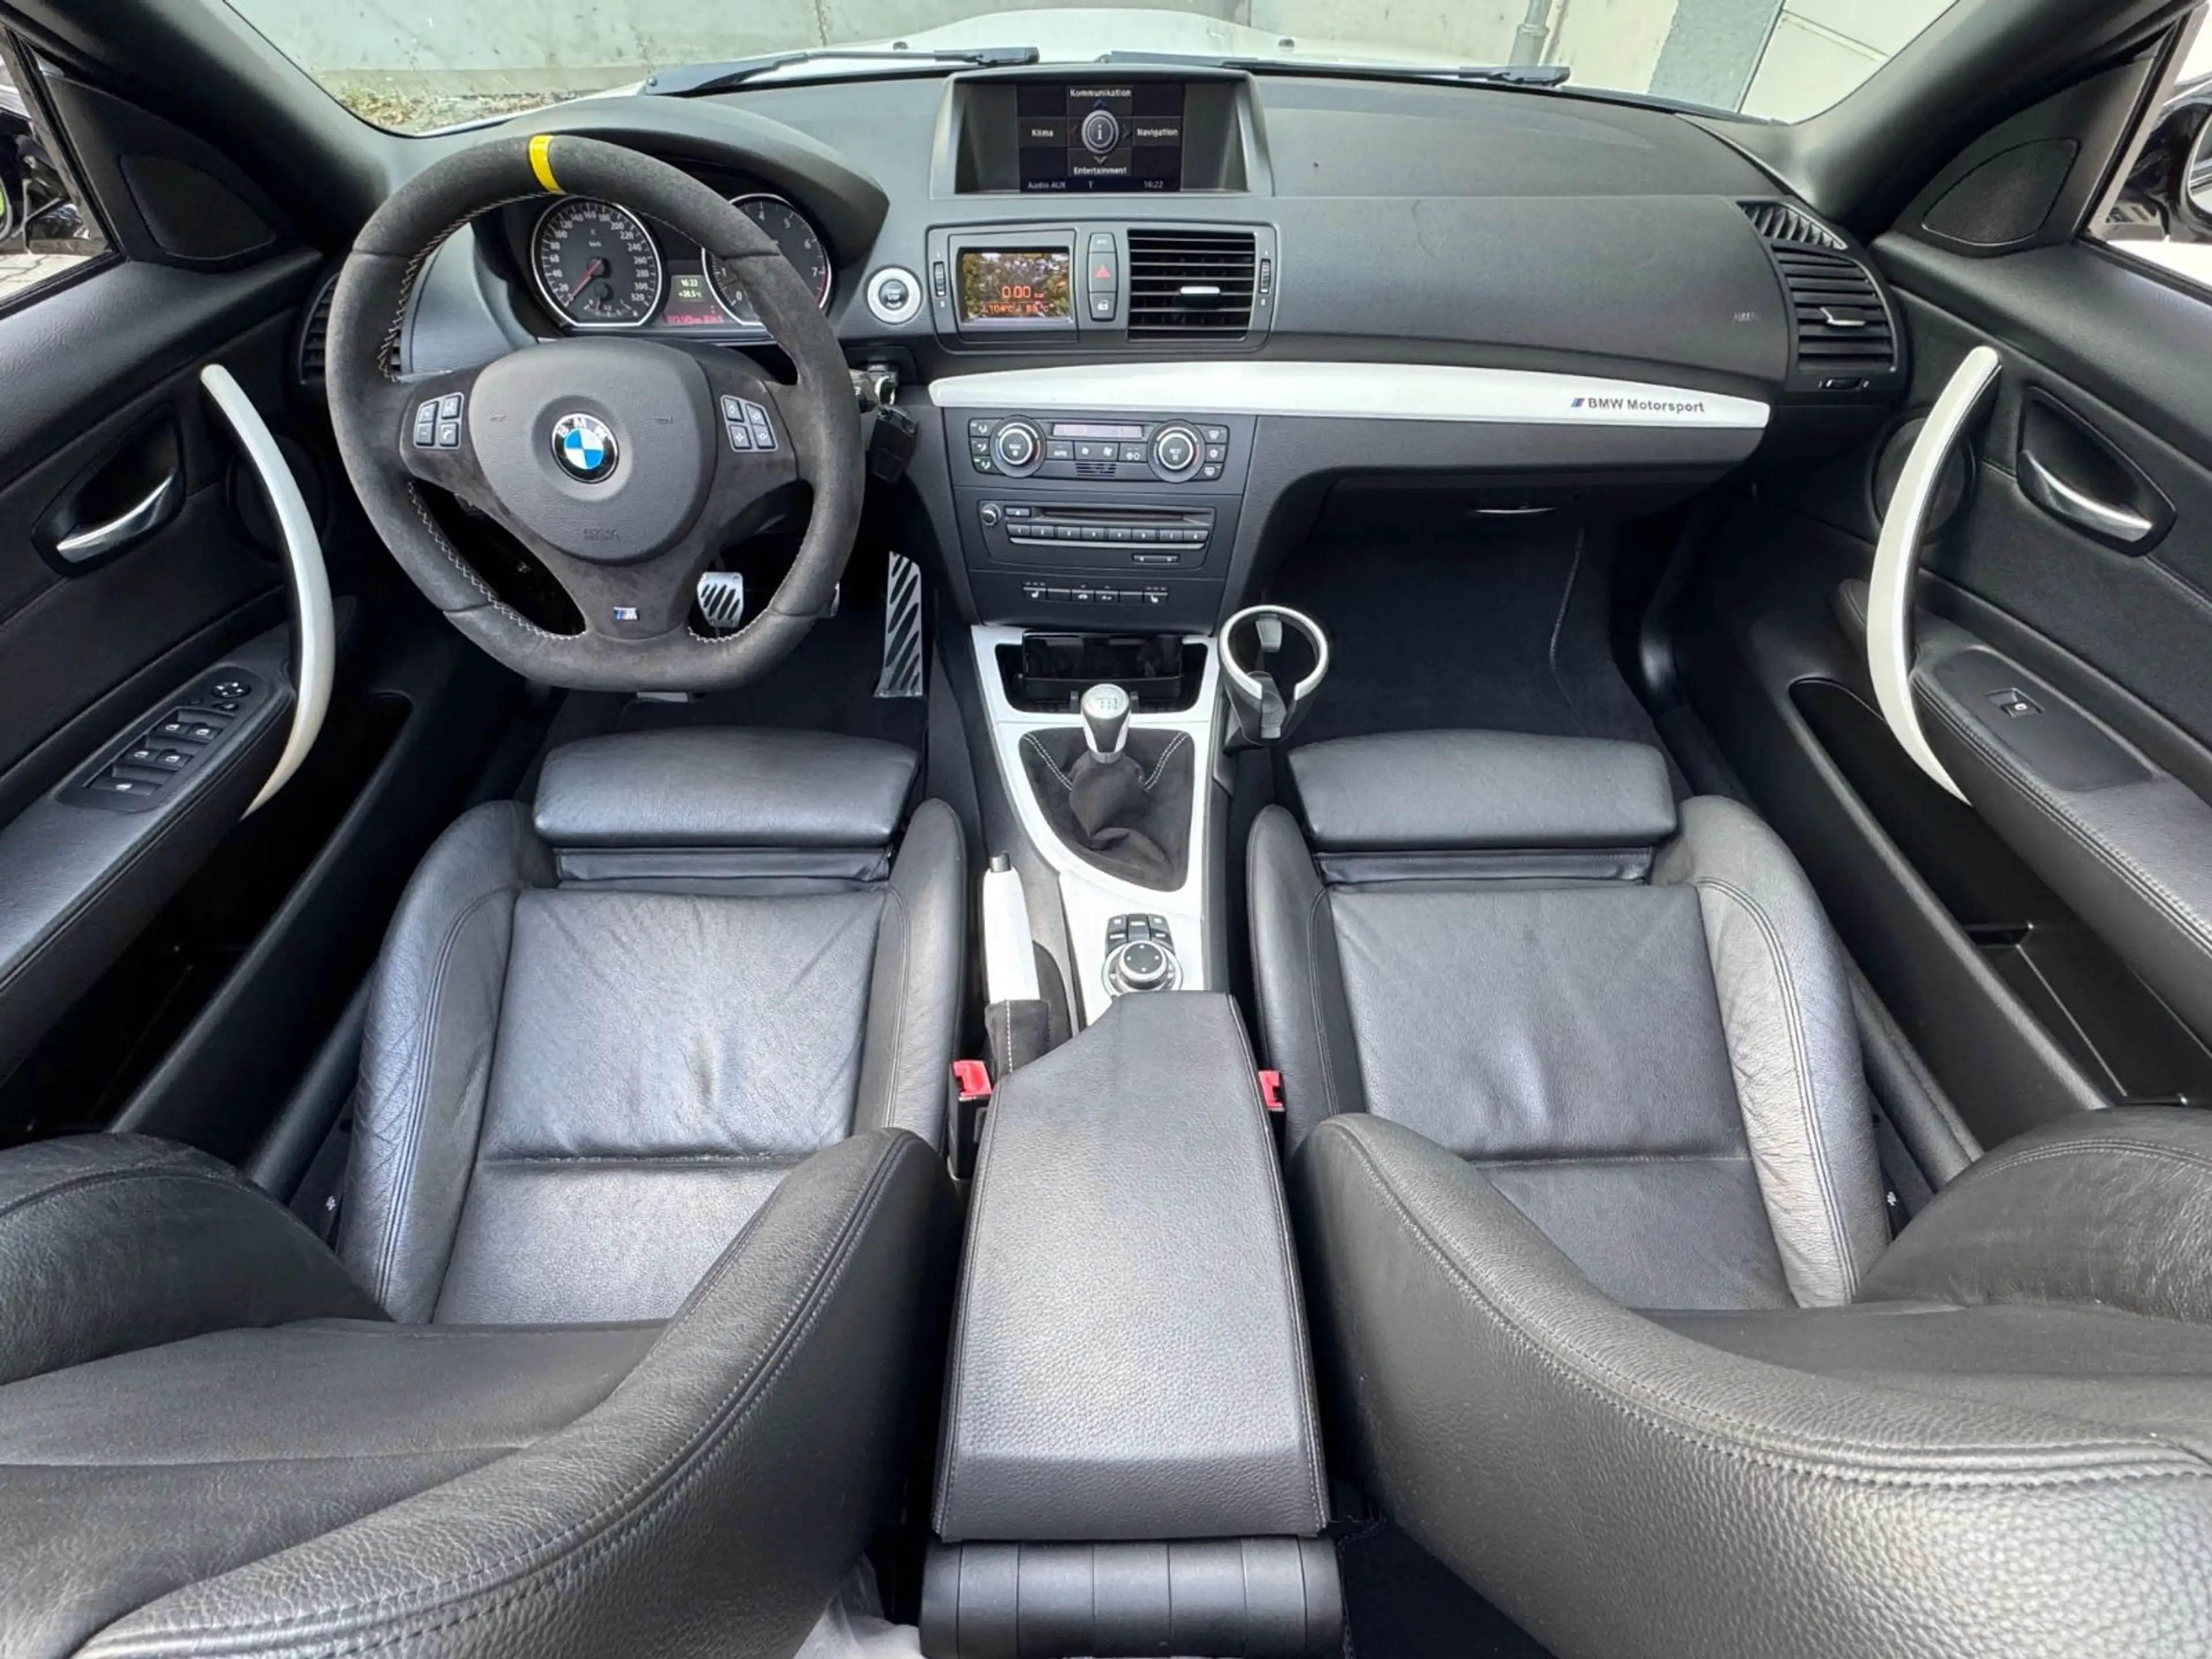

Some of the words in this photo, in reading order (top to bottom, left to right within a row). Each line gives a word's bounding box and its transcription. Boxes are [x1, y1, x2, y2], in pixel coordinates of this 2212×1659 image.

[1070, 89, 1131, 97] Kommunikation
[1032, 129, 1054, 137] Klima
[1137, 128, 1179, 138] Navigation
[1074, 166, 1127, 175] Entertainment
[1588, 397, 1624, 410] BMW
[1627, 399, 1705, 414] Motorsport
[556, 417, 611, 442] BMW
